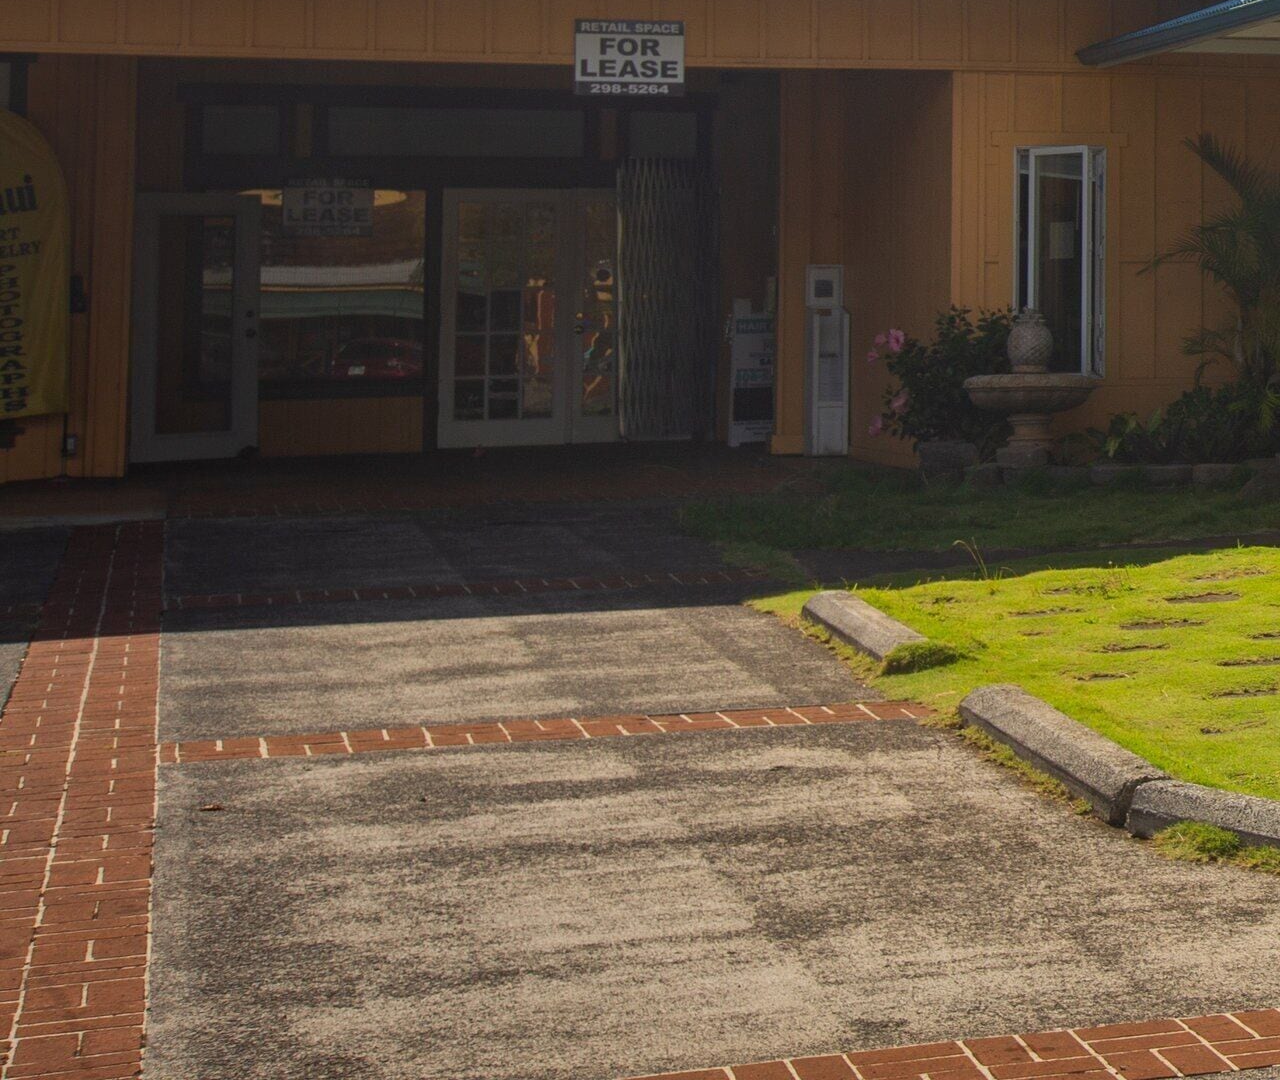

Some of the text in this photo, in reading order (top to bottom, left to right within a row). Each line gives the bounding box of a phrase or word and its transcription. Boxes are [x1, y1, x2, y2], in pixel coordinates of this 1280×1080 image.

[581, 22, 680, 33] RETAIL SPACE
[600, 37, 661, 56] FOR
[580, 59, 679, 79] LEASE
[590, 83, 669, 95] 298-5264
[303, 190, 353, 206] FOR
[287, 207, 369, 223] LEASE
